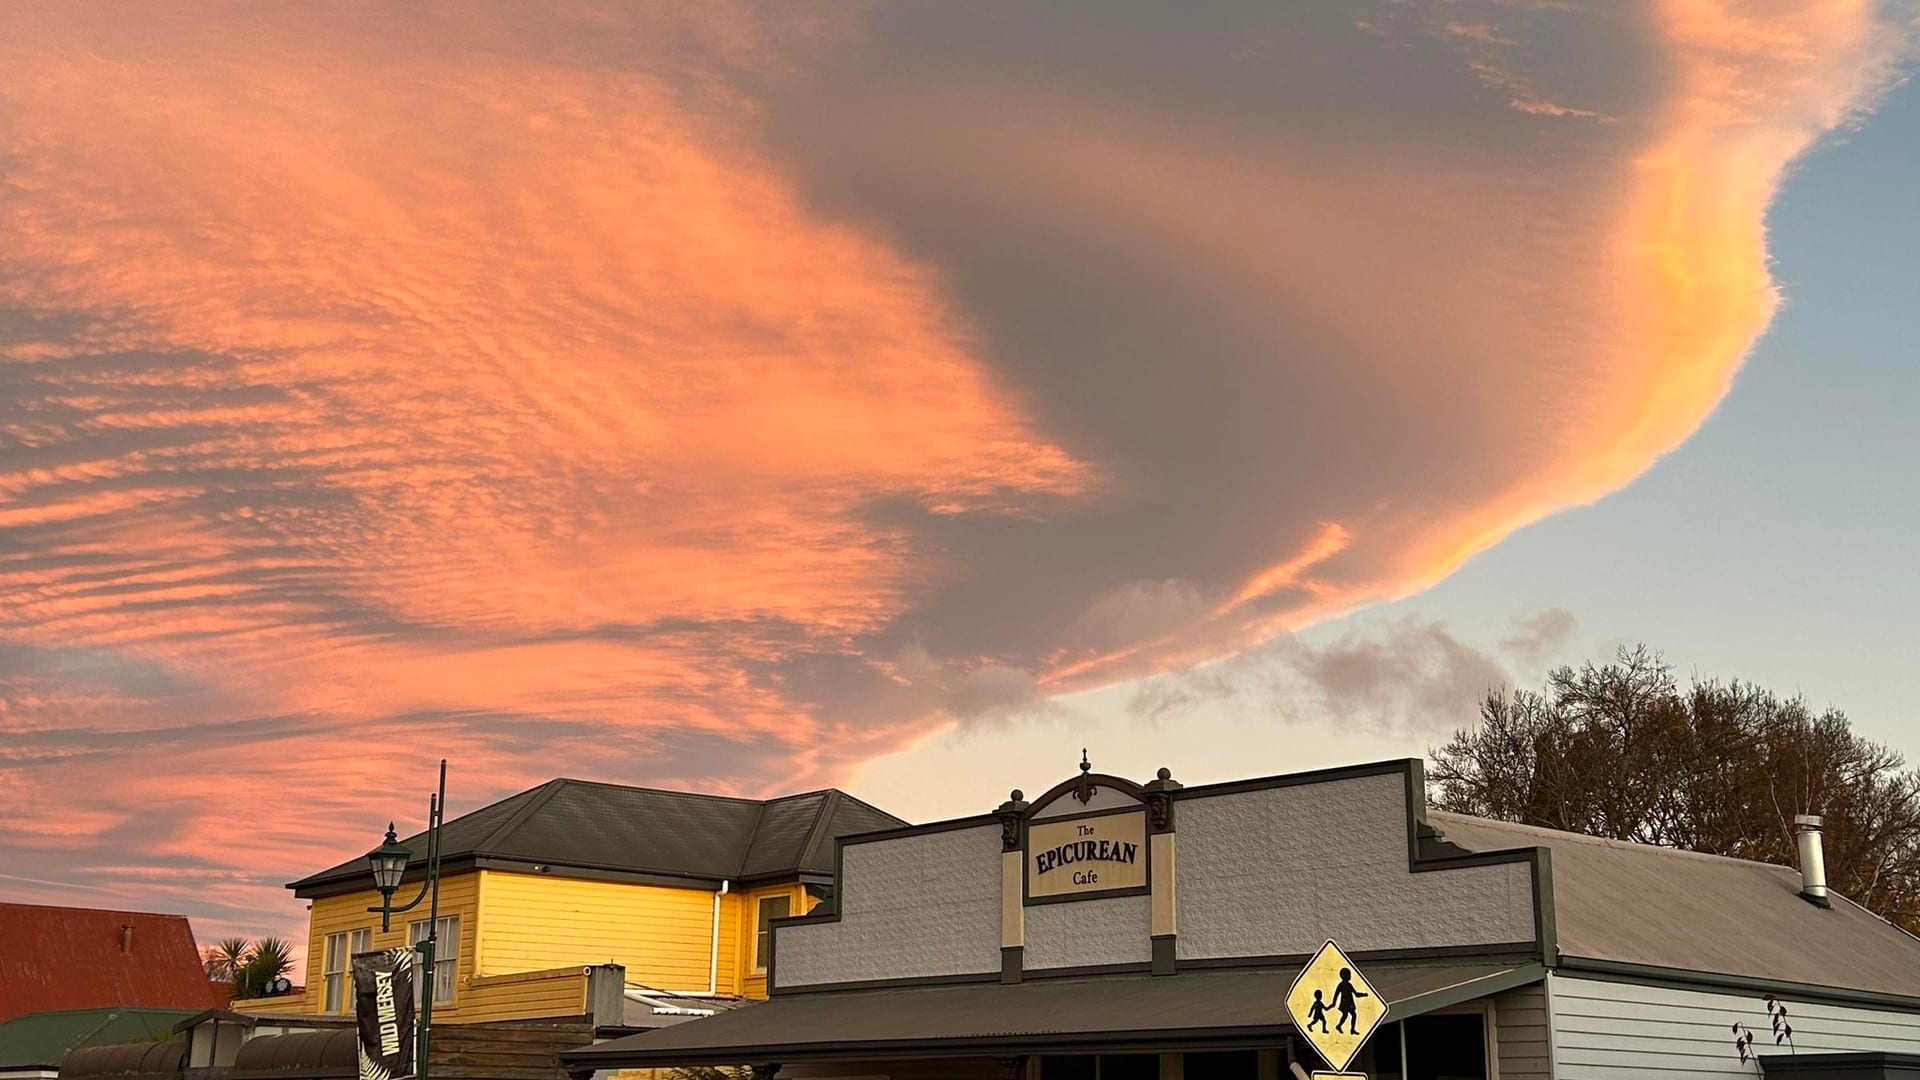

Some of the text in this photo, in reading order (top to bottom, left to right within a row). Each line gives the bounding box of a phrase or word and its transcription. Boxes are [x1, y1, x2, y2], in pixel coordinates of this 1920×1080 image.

[1077, 825, 1094, 836] The
[1035, 840, 1138, 875] EPICUREAN
[1073, 870, 1098, 885] Cafe
[375, 971, 400, 1057] WILD MERSEY
